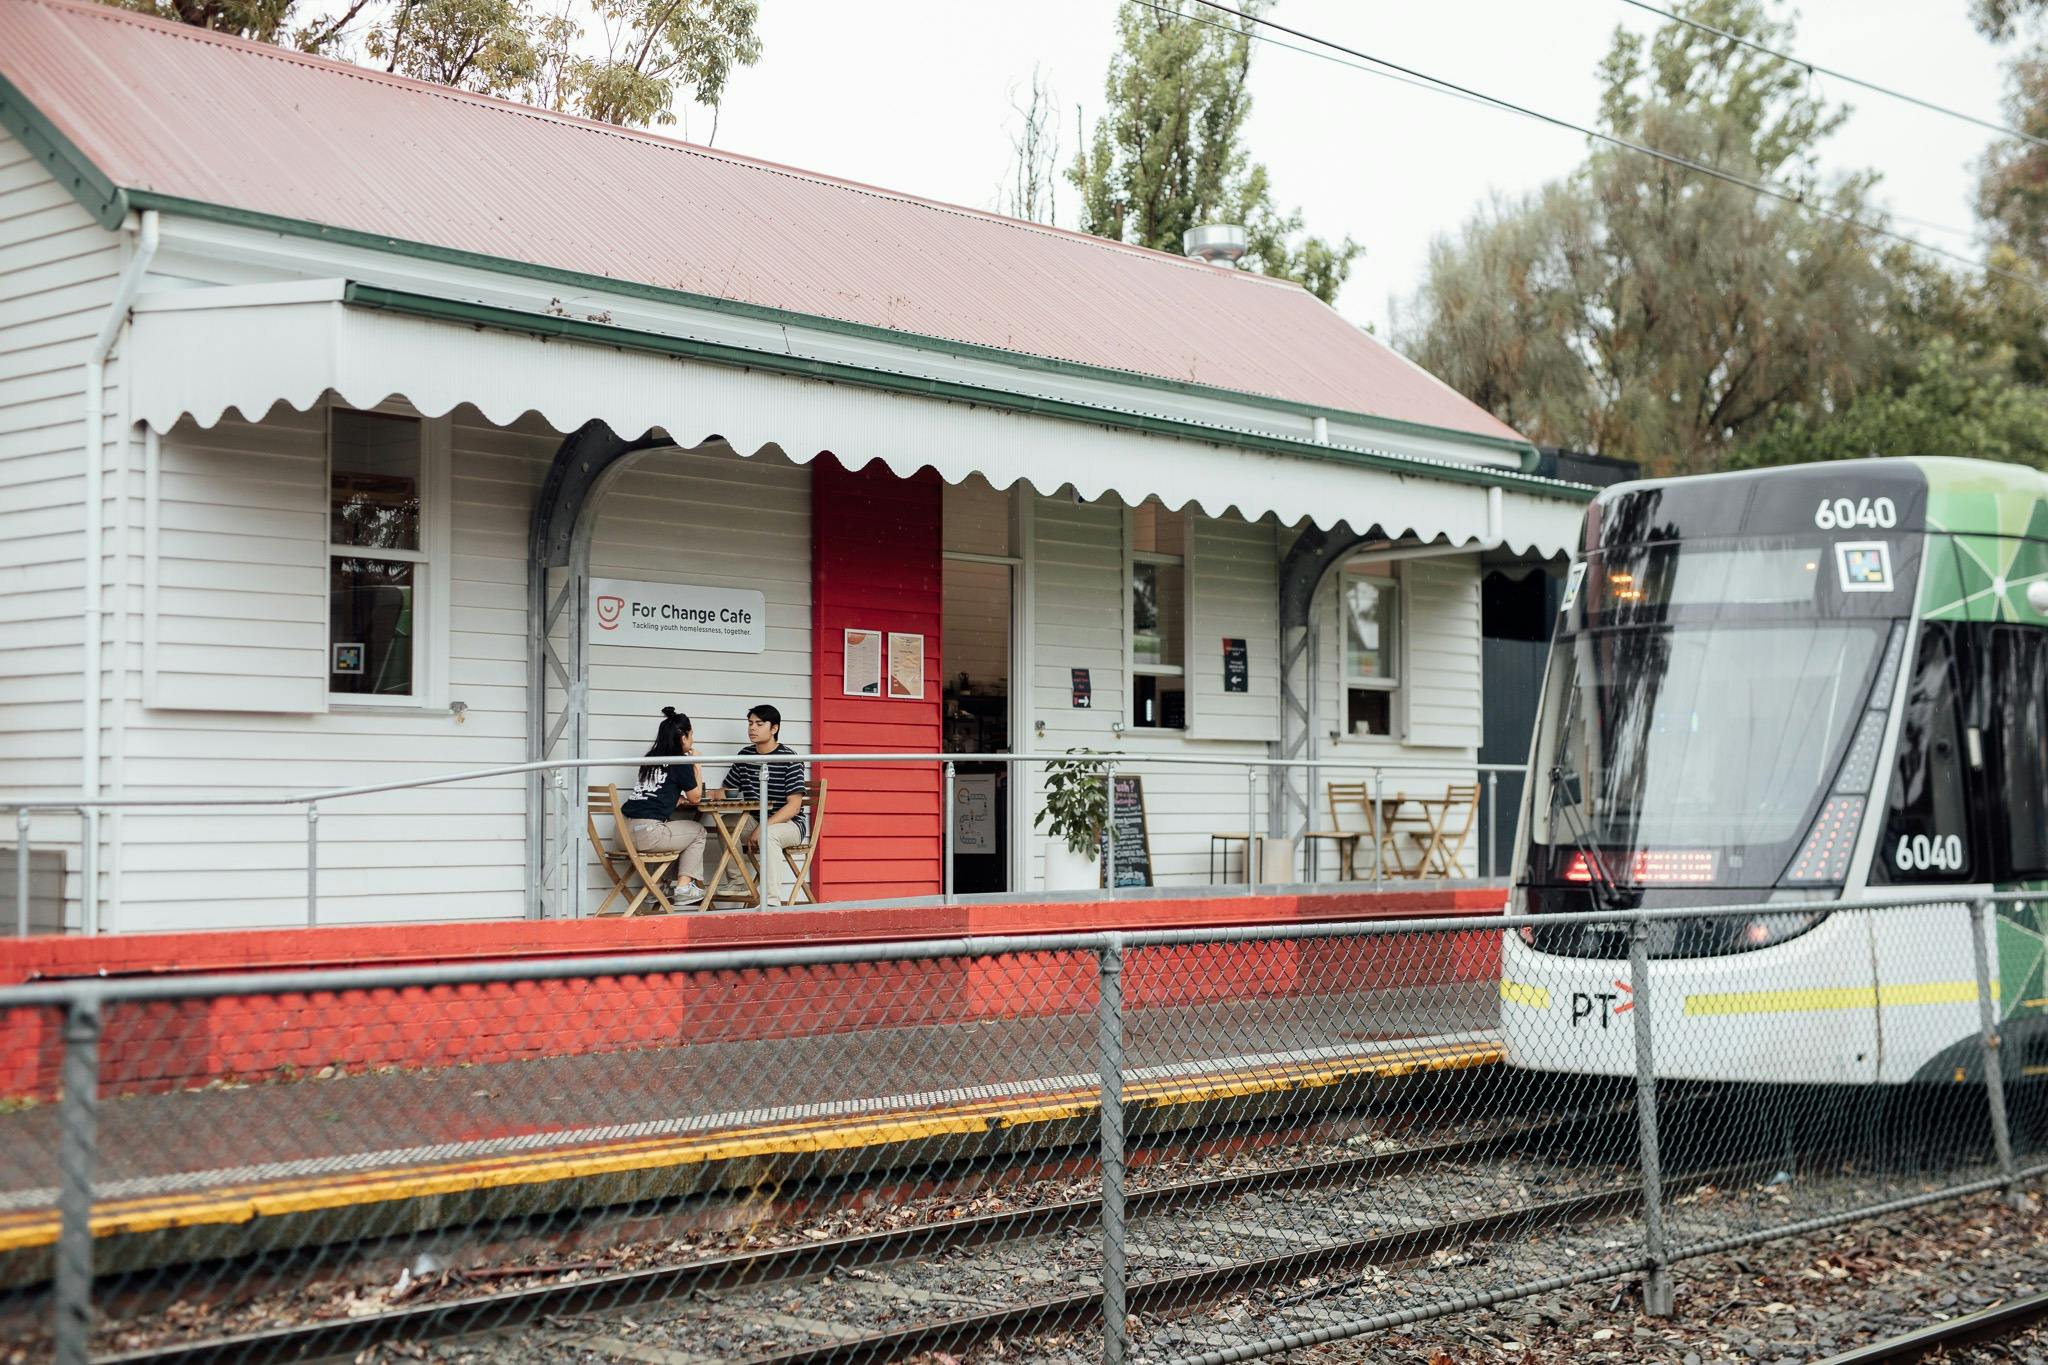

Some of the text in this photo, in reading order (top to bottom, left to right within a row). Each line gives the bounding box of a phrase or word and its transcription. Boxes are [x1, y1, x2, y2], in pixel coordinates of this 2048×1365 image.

[1815, 496, 1897, 530] 6040
[632, 602, 752, 624] For Change Cafe
[632, 622, 752, 636] Tackling youth homelessness, together.
[1895, 834, 1963, 871] 6040
